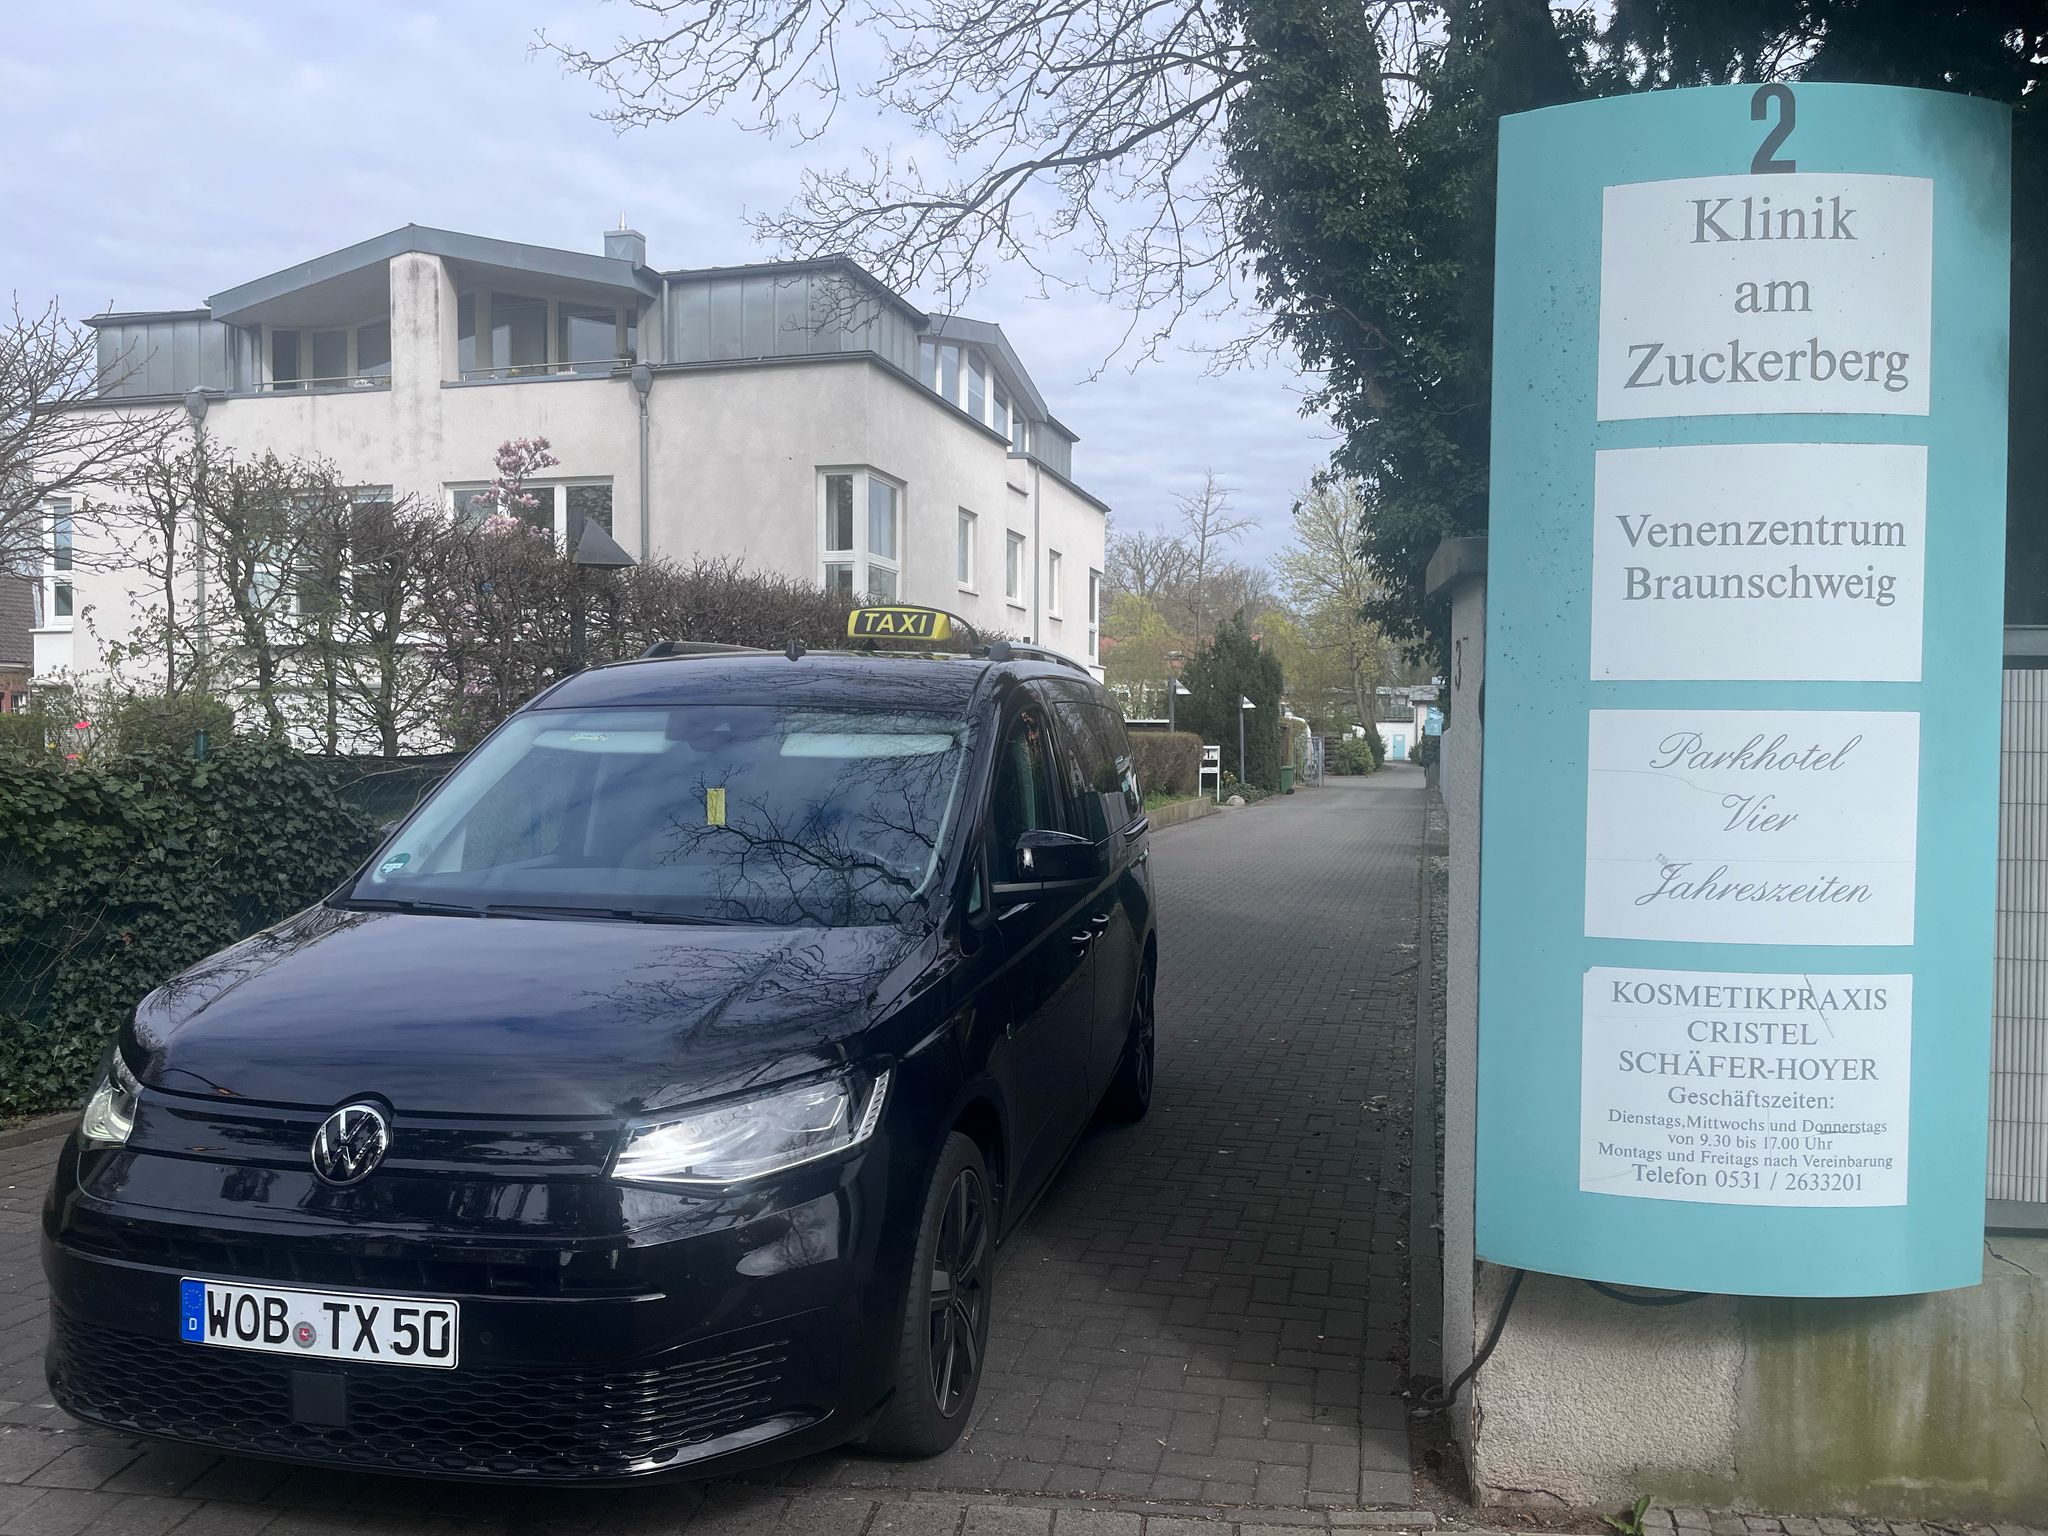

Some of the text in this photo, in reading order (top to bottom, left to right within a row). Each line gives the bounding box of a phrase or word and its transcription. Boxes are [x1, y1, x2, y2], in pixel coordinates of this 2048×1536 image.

[1750, 83, 1796, 174] 2
[1690, 195, 1858, 244] Klinik
[1734, 278, 1813, 314] am
[1623, 337, 1910, 393] Zuckerberg
[1616, 514, 1906, 548] Venenzentrum
[1622, 564, 1897, 606] Braunschweig
[864, 613, 928, 634] TAXI
[1649, 731, 1863, 772] Parkhotel
[1721, 793, 1799, 833] Vier
[1635, 862, 1872, 906] Jahreszeiten
[1612, 981, 1888, 1011] KOSMETIKPRAXIS
[1687, 1021, 1818, 1046] CRISTEL
[1619, 1050, 1880, 1081] SCHÄFER-HOYER
[1668, 1086, 1835, 1110] Geschäftszeiten:
[1668, 1133, 1833, 1150] von 9.30 bis 17.00 Uhr
[1769, 1120, 1797, 1132] und
[1802, 1120, 1887, 1135] Donnerstags
[1598, 1142, 1893, 1170] Montags und Freitags nach Vereinbarung
[1632, 1163, 1863, 1192] Telefon 0531 / 2633201
[188, 1290, 450, 1358] D WOB TX 50
